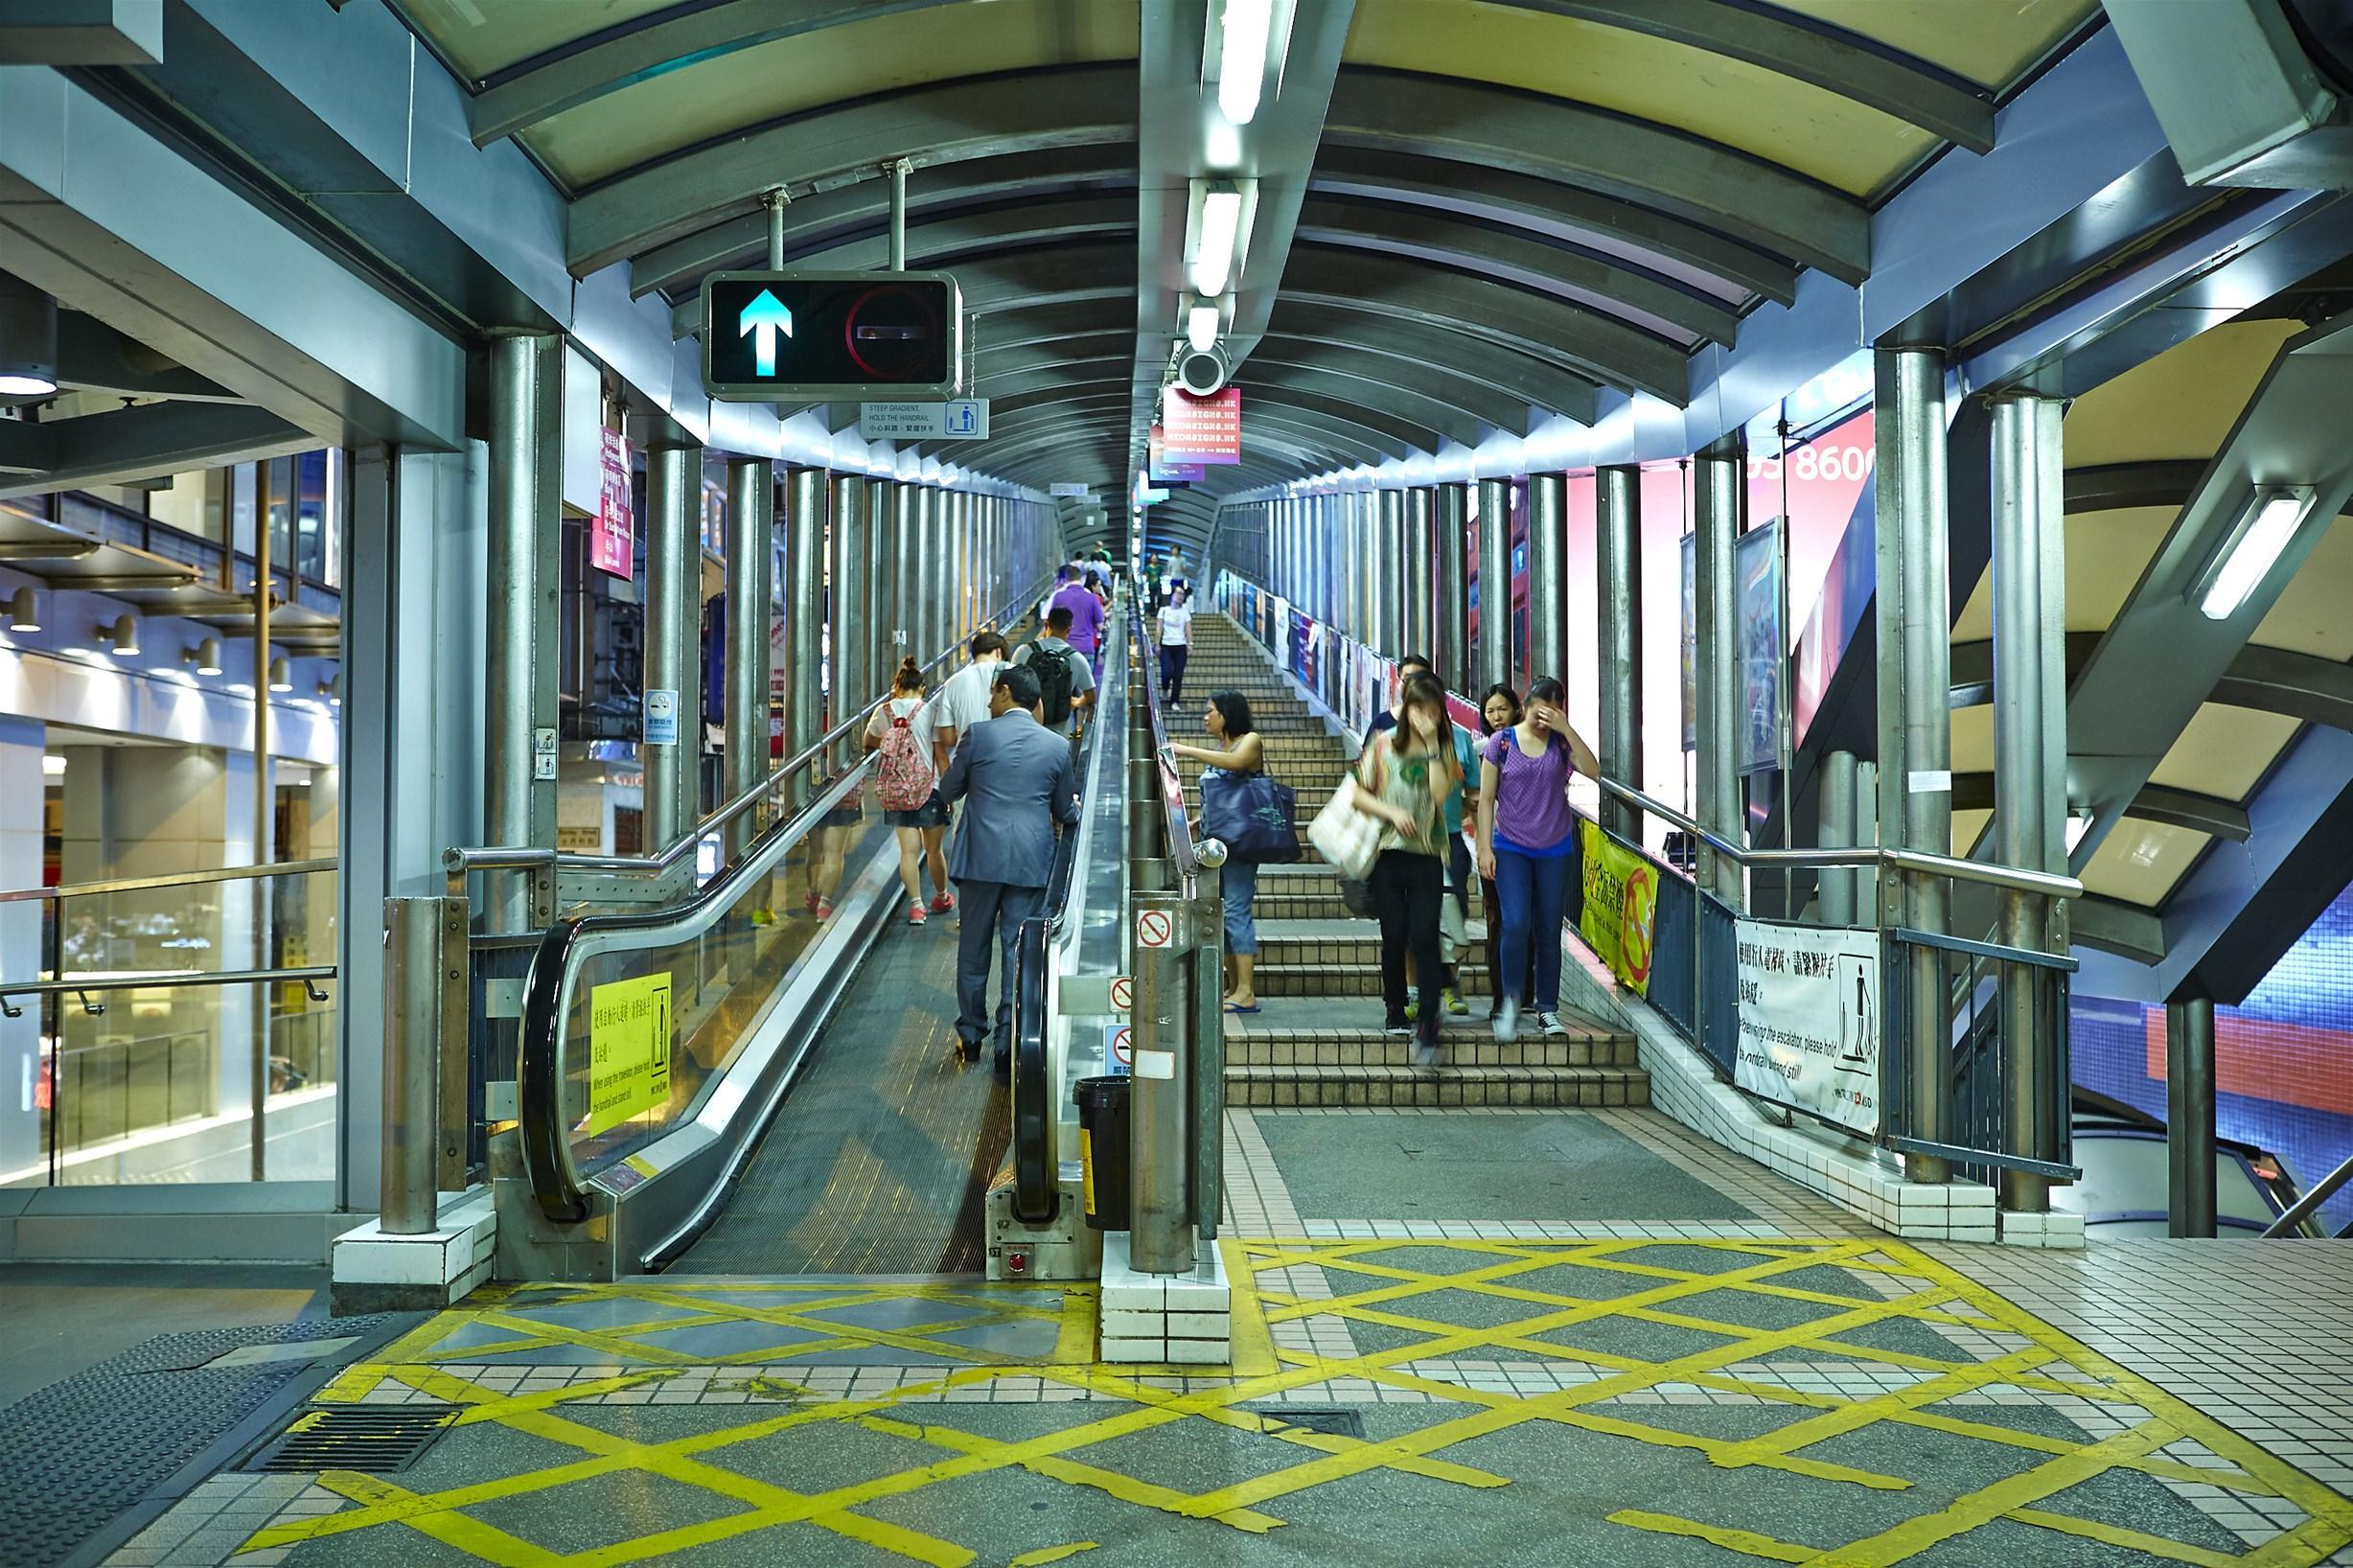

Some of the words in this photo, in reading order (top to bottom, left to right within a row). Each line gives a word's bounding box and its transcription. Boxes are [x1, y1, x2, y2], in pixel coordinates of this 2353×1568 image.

[888, 404, 920, 413] GRADIENT,
[1765, 1025, 1776, 1043] the
[1804, 1034, 1824, 1055] please
[1823, 1037, 1837, 1059] hold
[1786, 1062, 1803, 1081] still
